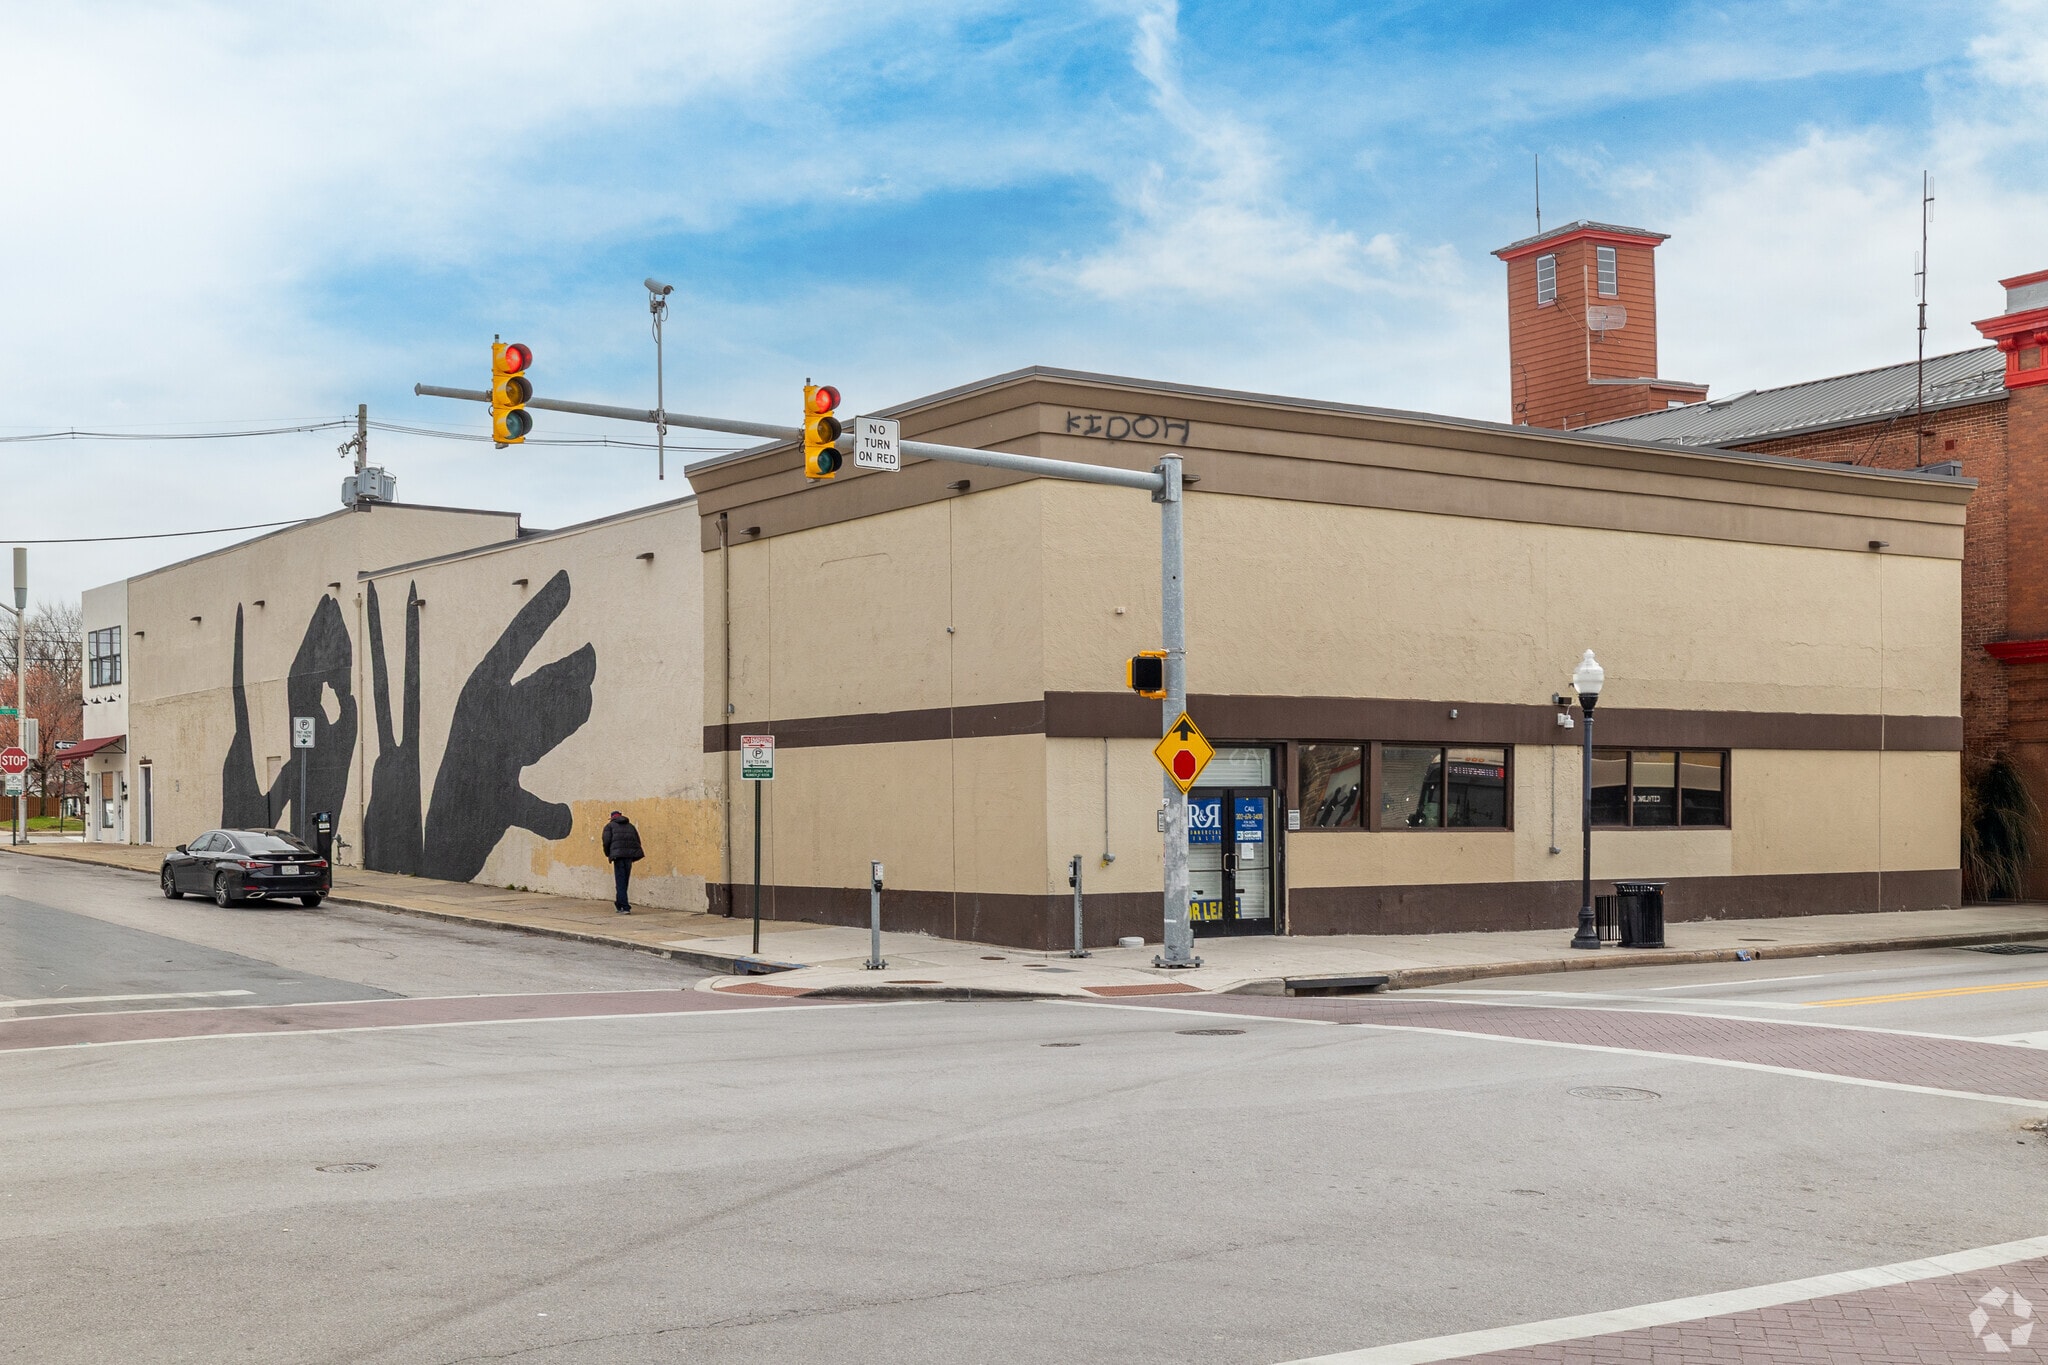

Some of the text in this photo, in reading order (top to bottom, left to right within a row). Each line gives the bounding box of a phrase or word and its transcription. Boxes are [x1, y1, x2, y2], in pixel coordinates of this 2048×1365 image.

[869, 424, 886, 435] NO
[864, 437, 890, 450] TURN
[859, 450, 896, 464] ON RED
[2, 755, 27, 766] STOP
